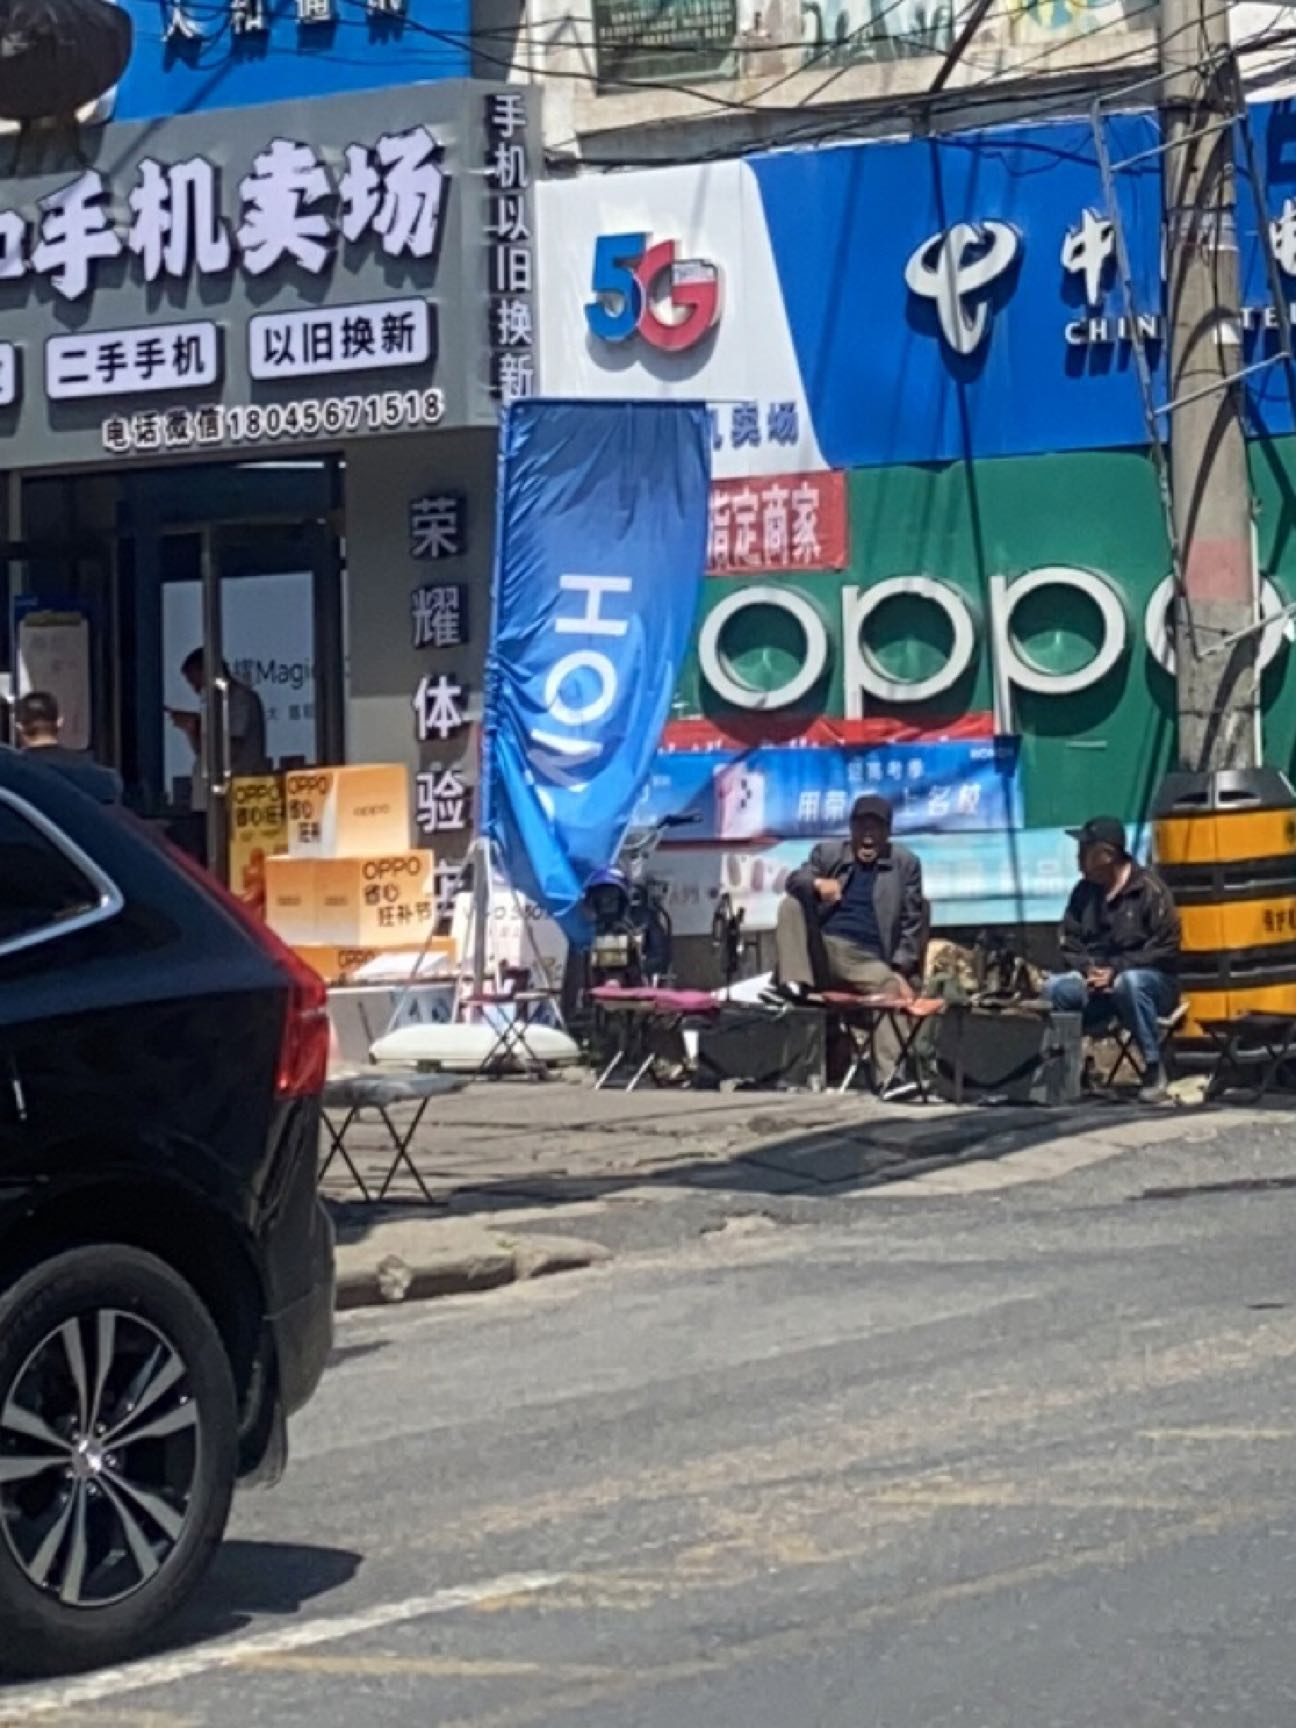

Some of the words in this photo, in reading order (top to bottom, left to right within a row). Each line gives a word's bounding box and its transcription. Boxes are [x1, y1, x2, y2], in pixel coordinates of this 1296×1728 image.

[492, 94, 533, 399] 手机以旧换新
[585, 232, 720, 352] 5G
[58, 333, 206, 384] 二手手机
[263, 312, 417, 365] 以旧换新
[708, 479, 823, 570] 指定商家
[287, 776, 329, 795] OPPO
[361, 856, 421, 881] OPPO
